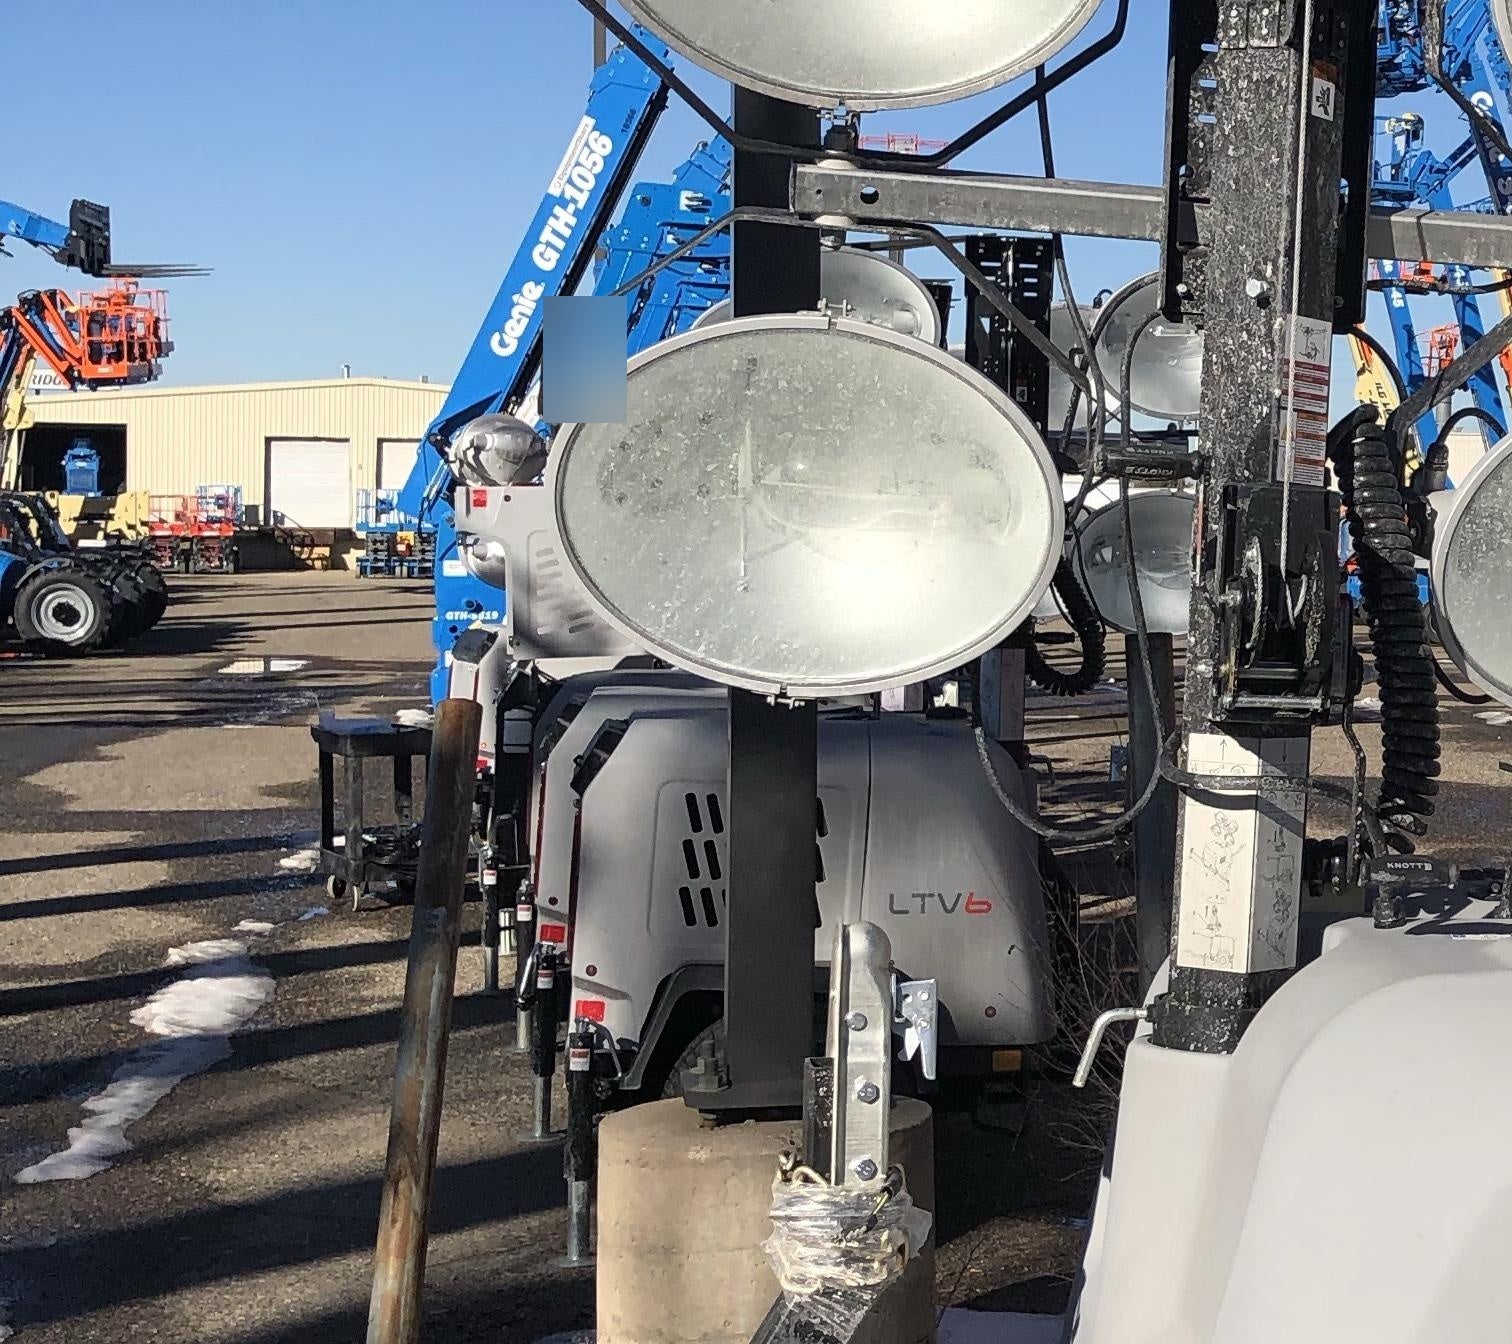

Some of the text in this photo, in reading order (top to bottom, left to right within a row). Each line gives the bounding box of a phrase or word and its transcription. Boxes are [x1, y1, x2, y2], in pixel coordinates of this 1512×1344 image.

[532, 131, 613, 272] GTH-1056
[489, 280, 545, 357] Genie
[889, 892, 993, 915] LTV6
